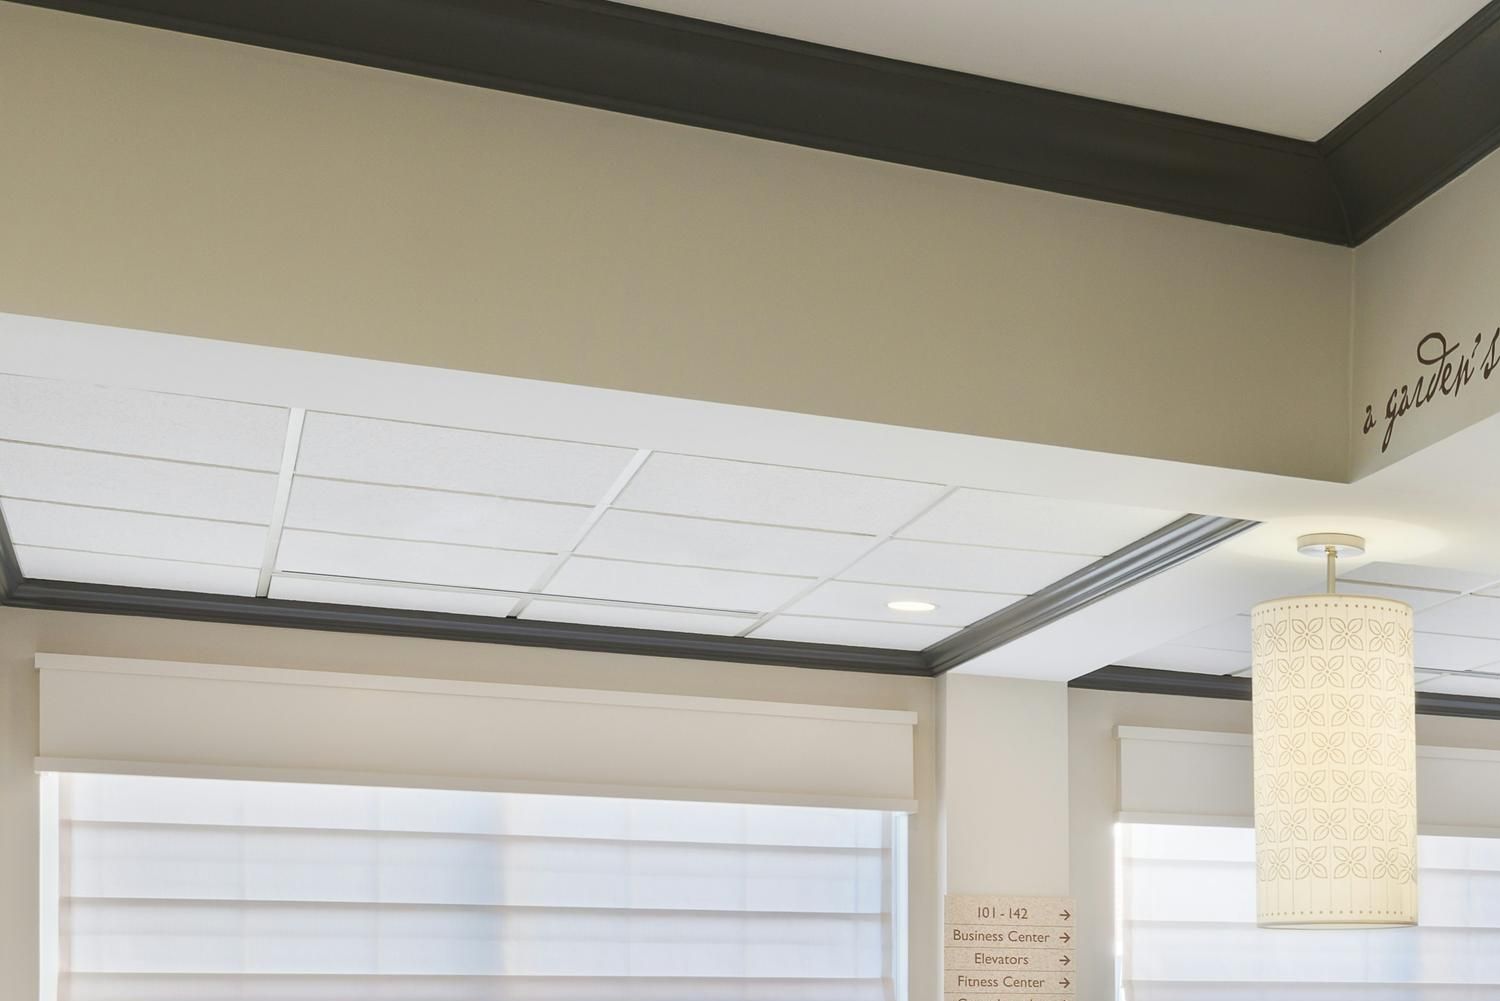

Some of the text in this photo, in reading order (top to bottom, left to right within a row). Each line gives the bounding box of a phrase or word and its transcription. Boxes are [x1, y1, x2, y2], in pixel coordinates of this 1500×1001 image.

[1362, 403, 1377, 435] a
[952, 928, 1051, 943] Business Center
[974, 952, 1030, 965] Elevators
[957, 974, 1046, 988] Fitness Center
